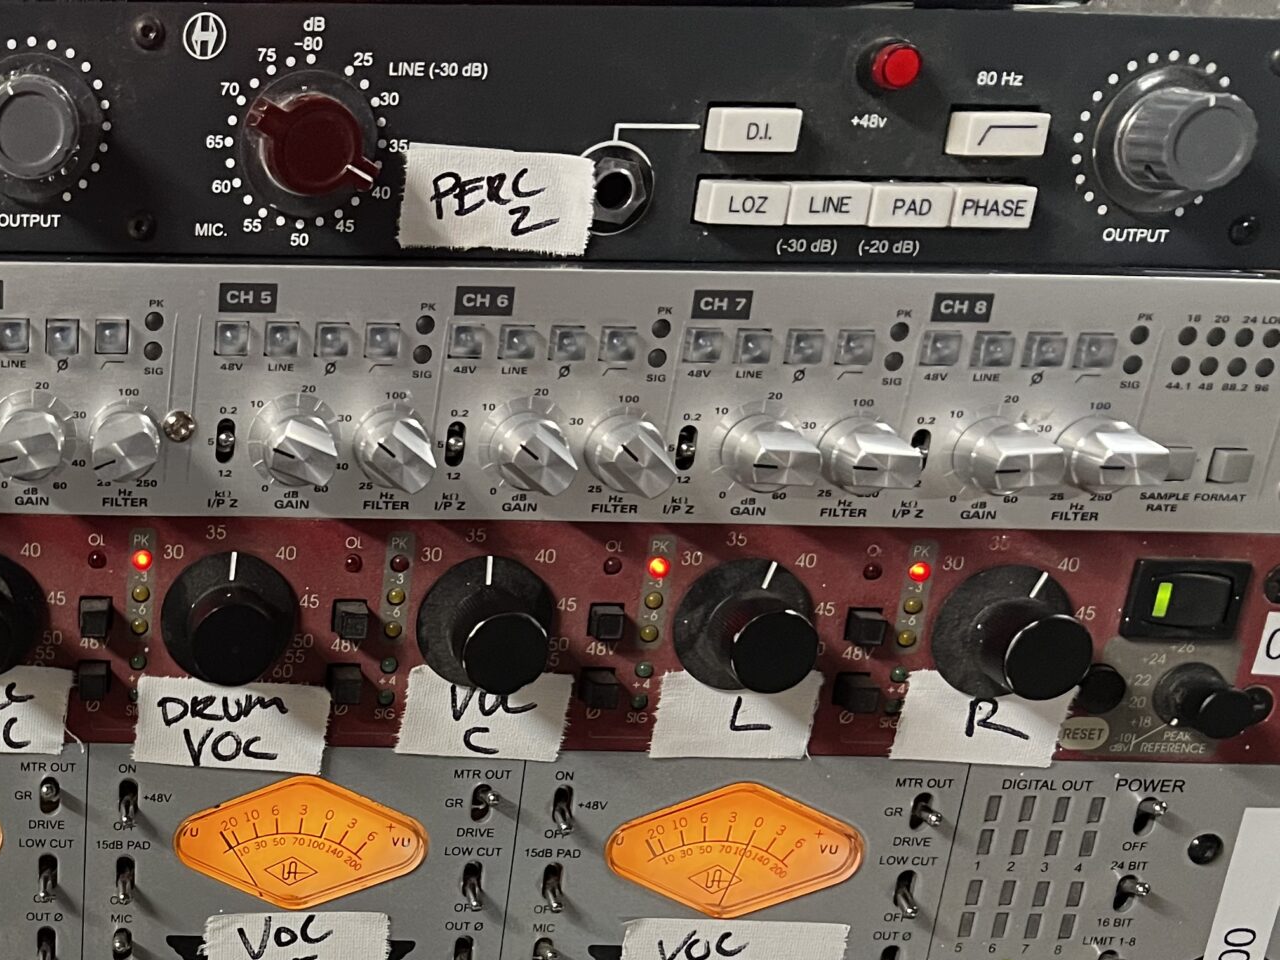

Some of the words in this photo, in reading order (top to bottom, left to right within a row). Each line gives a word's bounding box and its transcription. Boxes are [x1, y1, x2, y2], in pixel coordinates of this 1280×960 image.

[977, 72, 998, 87] 80
[1001, 72, 1024, 87] Hz
[746, 123, 772, 141] D.I.
[430, 168, 545, 220] PERC
[729, 196, 768, 214] LOZ
[808, 196, 852, 214] LINE
[891, 198, 932, 216] PAD
[961, 199, 1027, 217] PHASE
[509, 205, 560, 237] 2
[1102, 228, 1170, 243] OUTPUT
[227, 291, 255, 304] CH
[260, 291, 272, 304] 5
[463, 294, 491, 307] CH
[497, 294, 509, 307] 6
[700, 298, 728, 311] CH
[735, 298, 747, 311] 7
[940, 300, 968, 314] CH
[975, 301, 987, 315] 8
[730, 696, 771, 731] L
[965, 698, 1029, 740] R
[463, 727, 499, 754] C
[1062, 727, 1104, 739] RESET
[184, 728, 278, 766] VOC
[1002, 779, 1058, 791] DIGITAL
[1062, 780, 1093, 791] OUT
[1115, 779, 1185, 792] POWER
[238, 915, 333, 960] VOC
